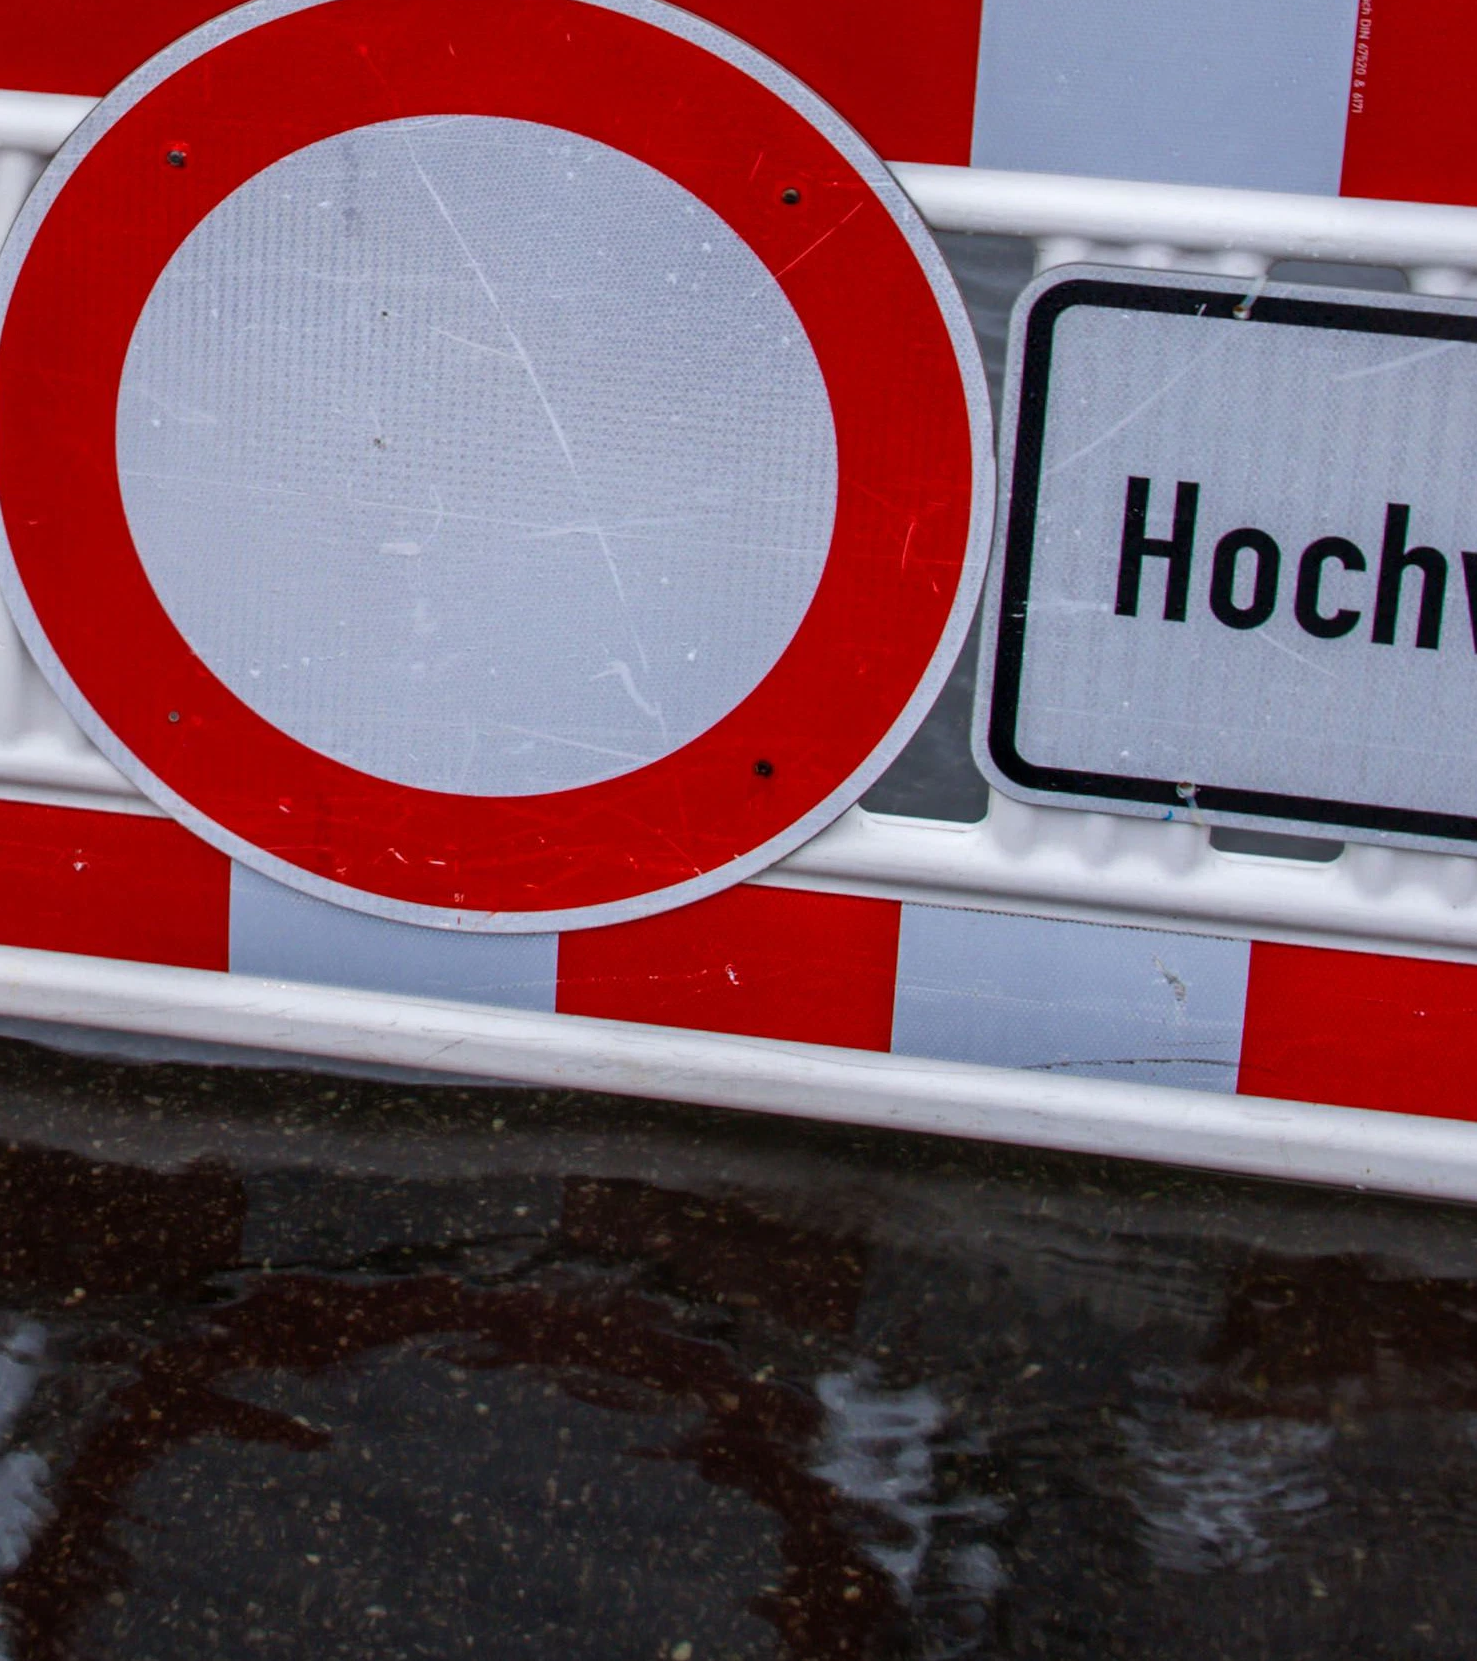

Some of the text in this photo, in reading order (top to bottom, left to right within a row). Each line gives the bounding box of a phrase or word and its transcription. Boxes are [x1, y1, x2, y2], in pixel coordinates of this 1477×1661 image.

[1359, 19, 1371, 39] DIN
[1355, 43, 1369, 75] 67520
[1351, 91, 1363, 113] 6171
